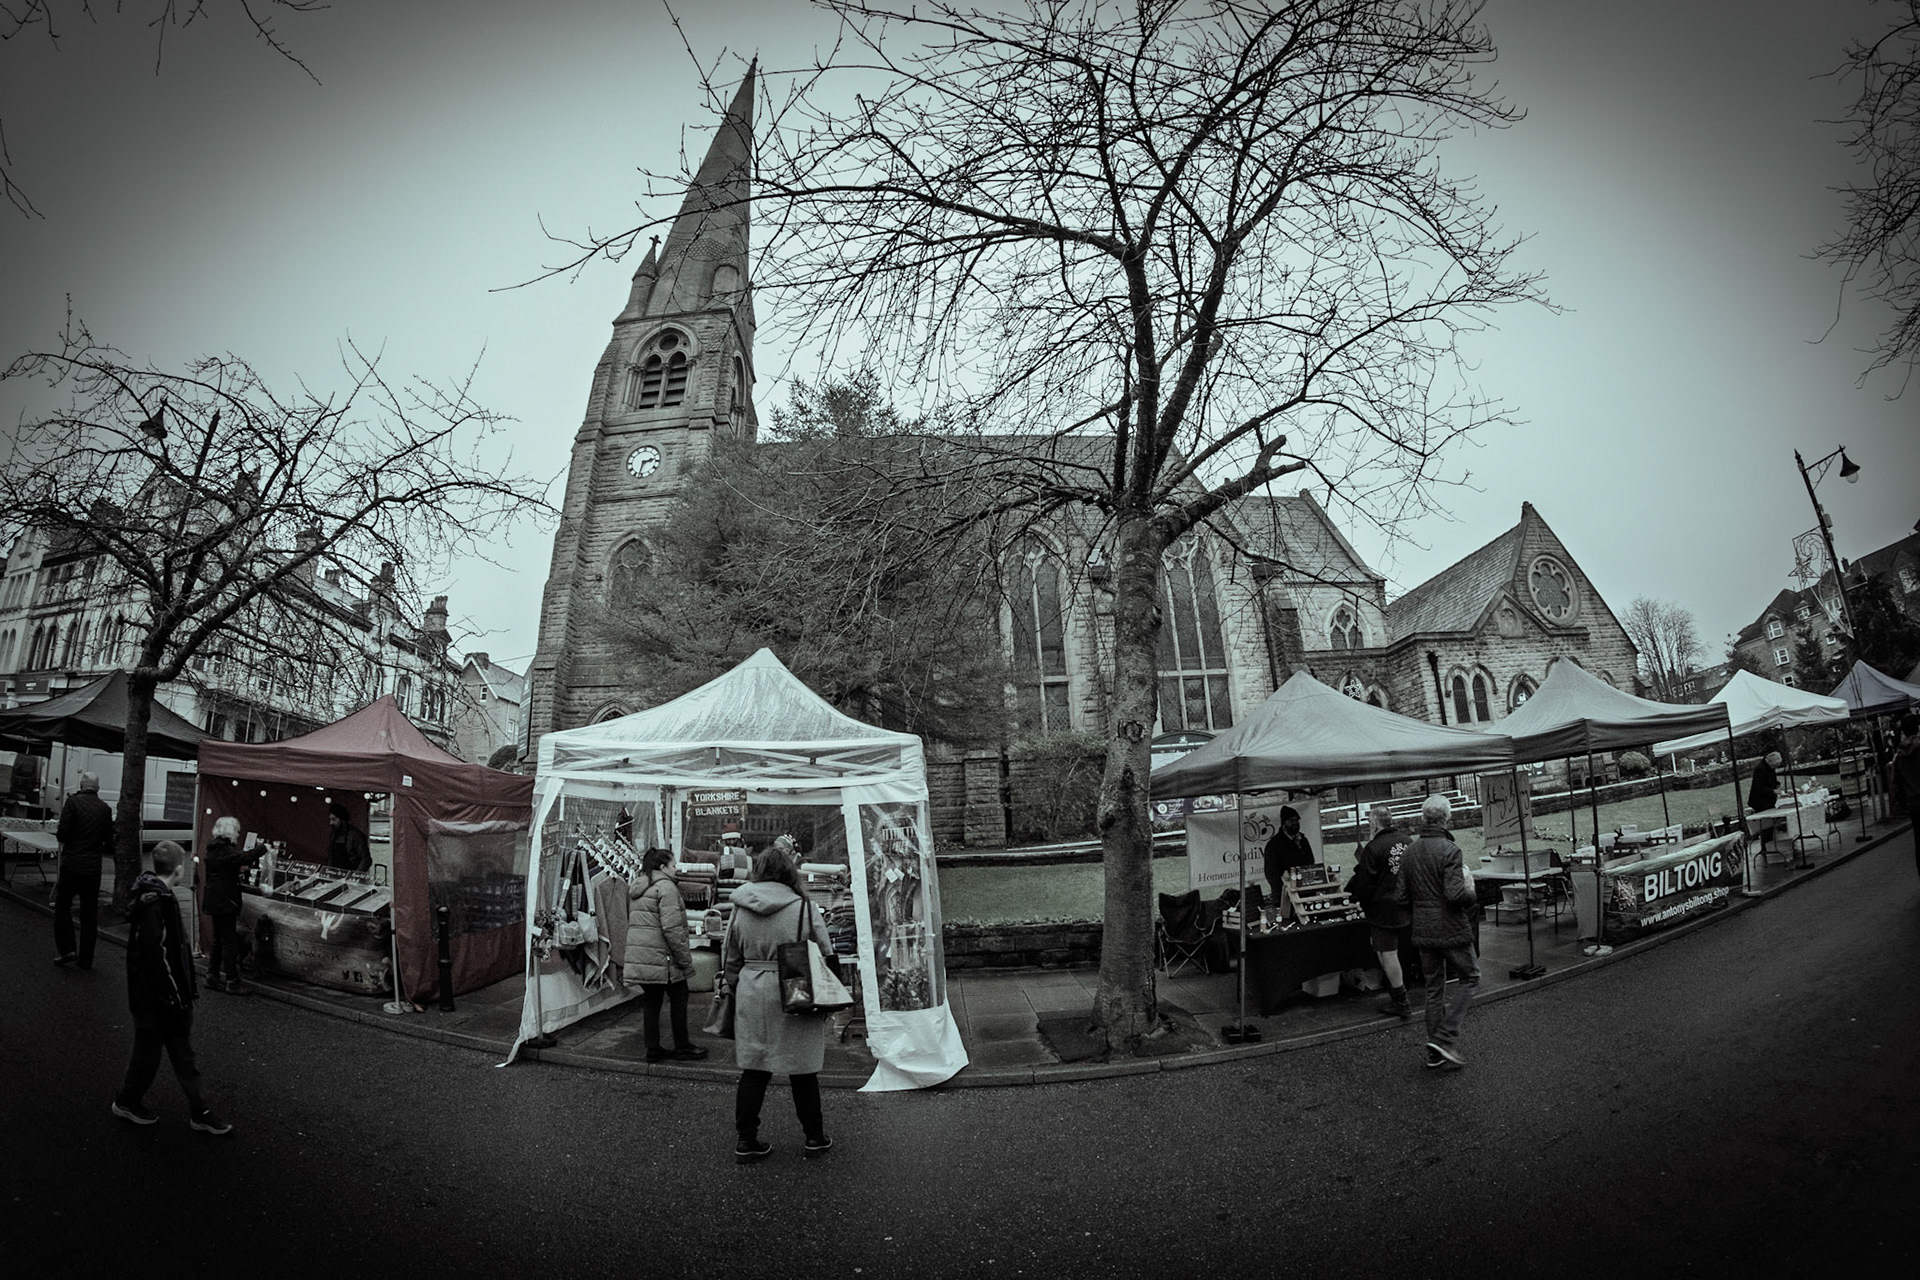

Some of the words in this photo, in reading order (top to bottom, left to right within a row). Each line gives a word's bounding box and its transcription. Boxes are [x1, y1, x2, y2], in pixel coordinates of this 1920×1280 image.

[694, 791, 740, 802] YORKSHIRE
[695, 805, 739, 816] BLANKETS
[1198, 870, 1245, 882] Homema
[1643, 851, 1722, 903] BILTONG
[1640, 886, 1730, 927] www.antonysbiltong.shop
